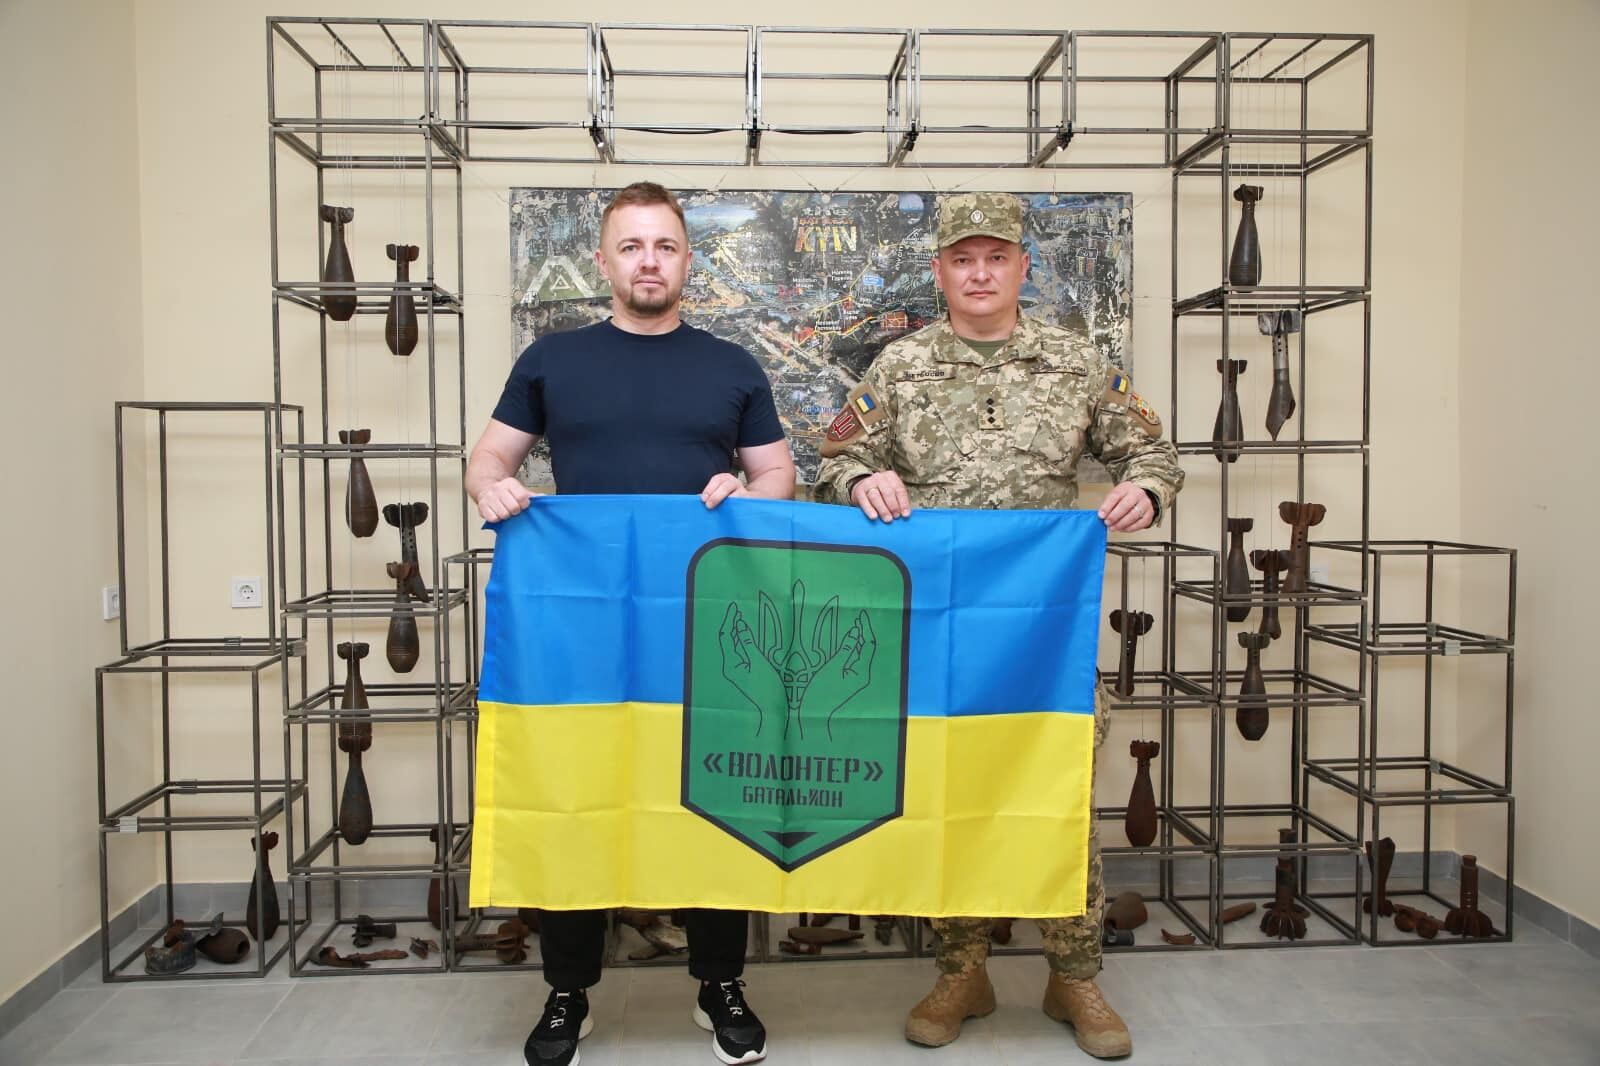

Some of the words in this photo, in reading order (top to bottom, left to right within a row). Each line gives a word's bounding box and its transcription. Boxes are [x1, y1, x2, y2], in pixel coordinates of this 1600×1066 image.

[795, 226, 857, 252] KYIV
[703, 752, 884, 783] «ВОЛОНТЕР»
[743, 786, 843, 808] БАТАЛЬЙОН
